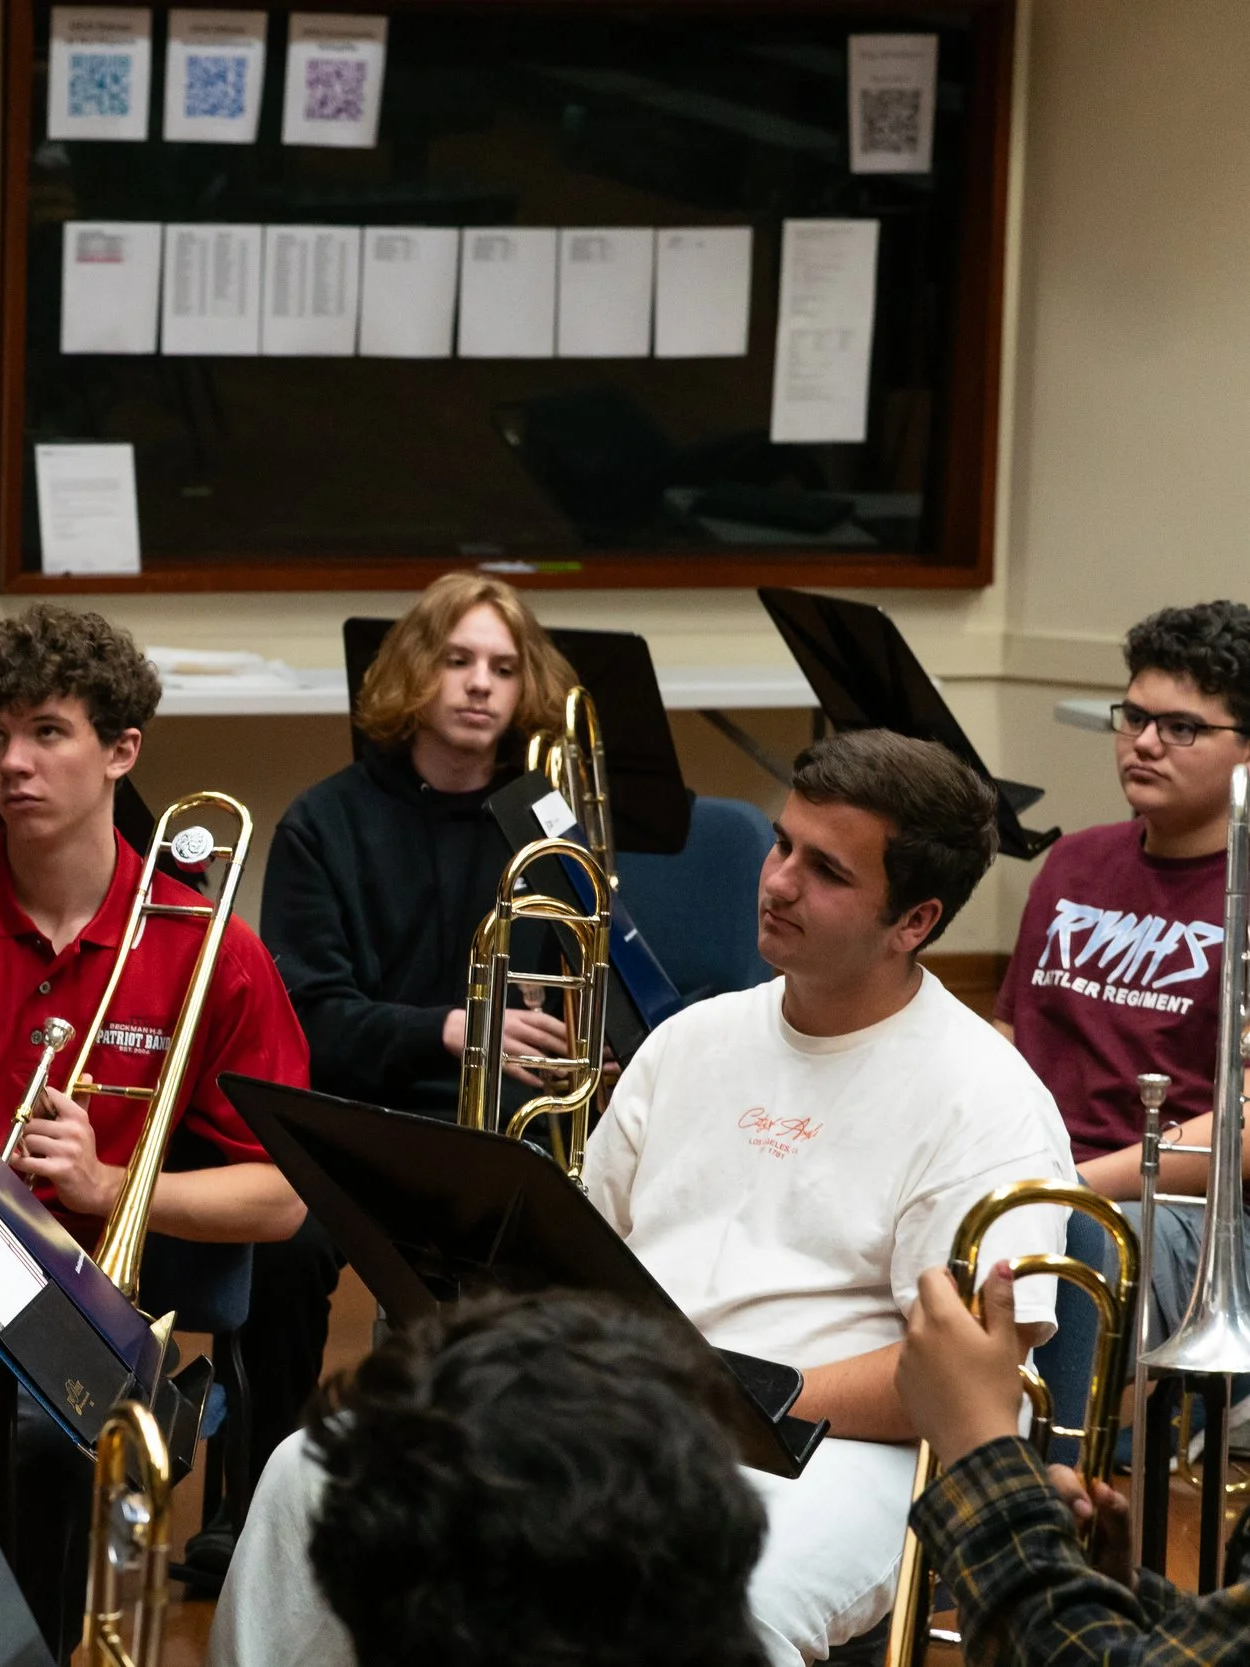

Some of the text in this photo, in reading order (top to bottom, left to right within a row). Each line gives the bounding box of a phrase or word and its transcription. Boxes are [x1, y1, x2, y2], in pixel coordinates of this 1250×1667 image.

[1102, 985, 1194, 1015] REGIMENT
[109, 1023, 148, 1033] BECKMAN
[96, 1029, 143, 1047] PATRIOT
